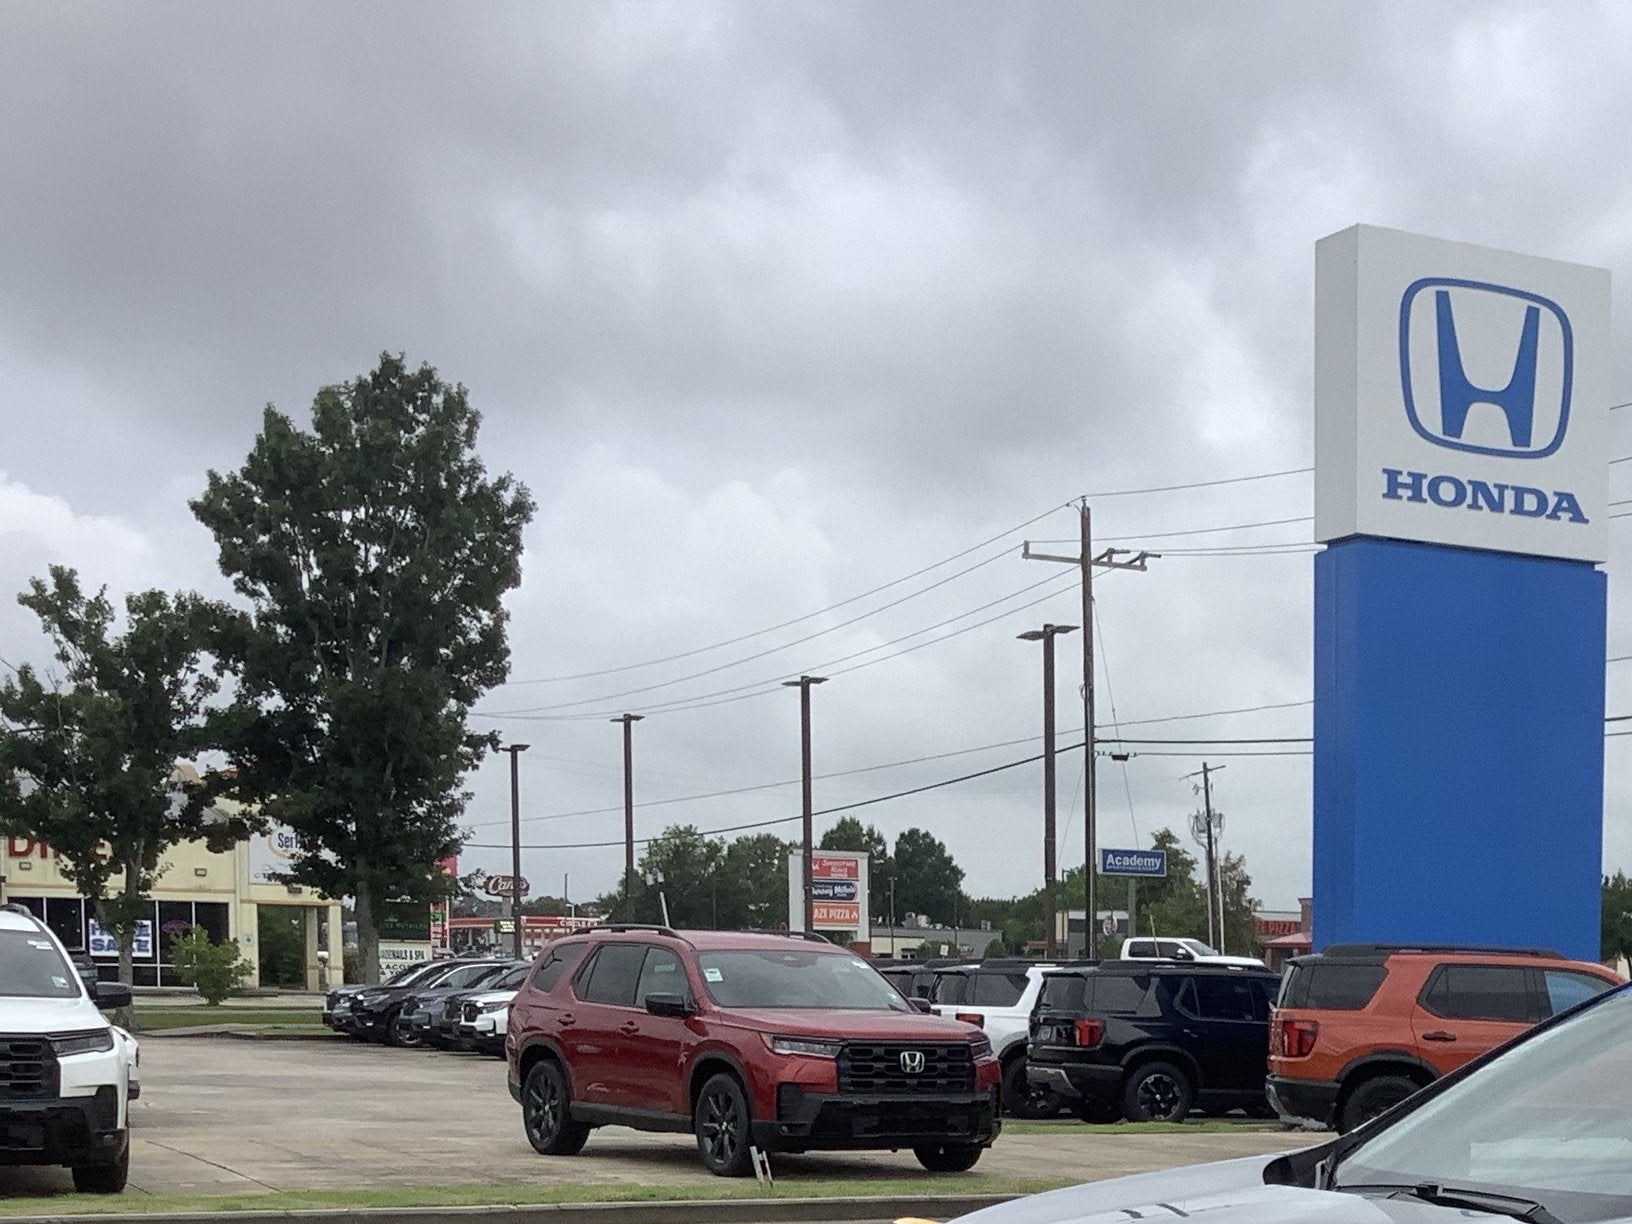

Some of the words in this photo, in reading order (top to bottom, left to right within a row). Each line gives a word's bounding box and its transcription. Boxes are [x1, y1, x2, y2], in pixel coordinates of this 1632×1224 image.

[1381, 467, 1590, 525] HONDA
[1106, 853, 1162, 871] Academy
[829, 908, 850, 919] PIZZA
[91, 938, 150, 952] SAE
